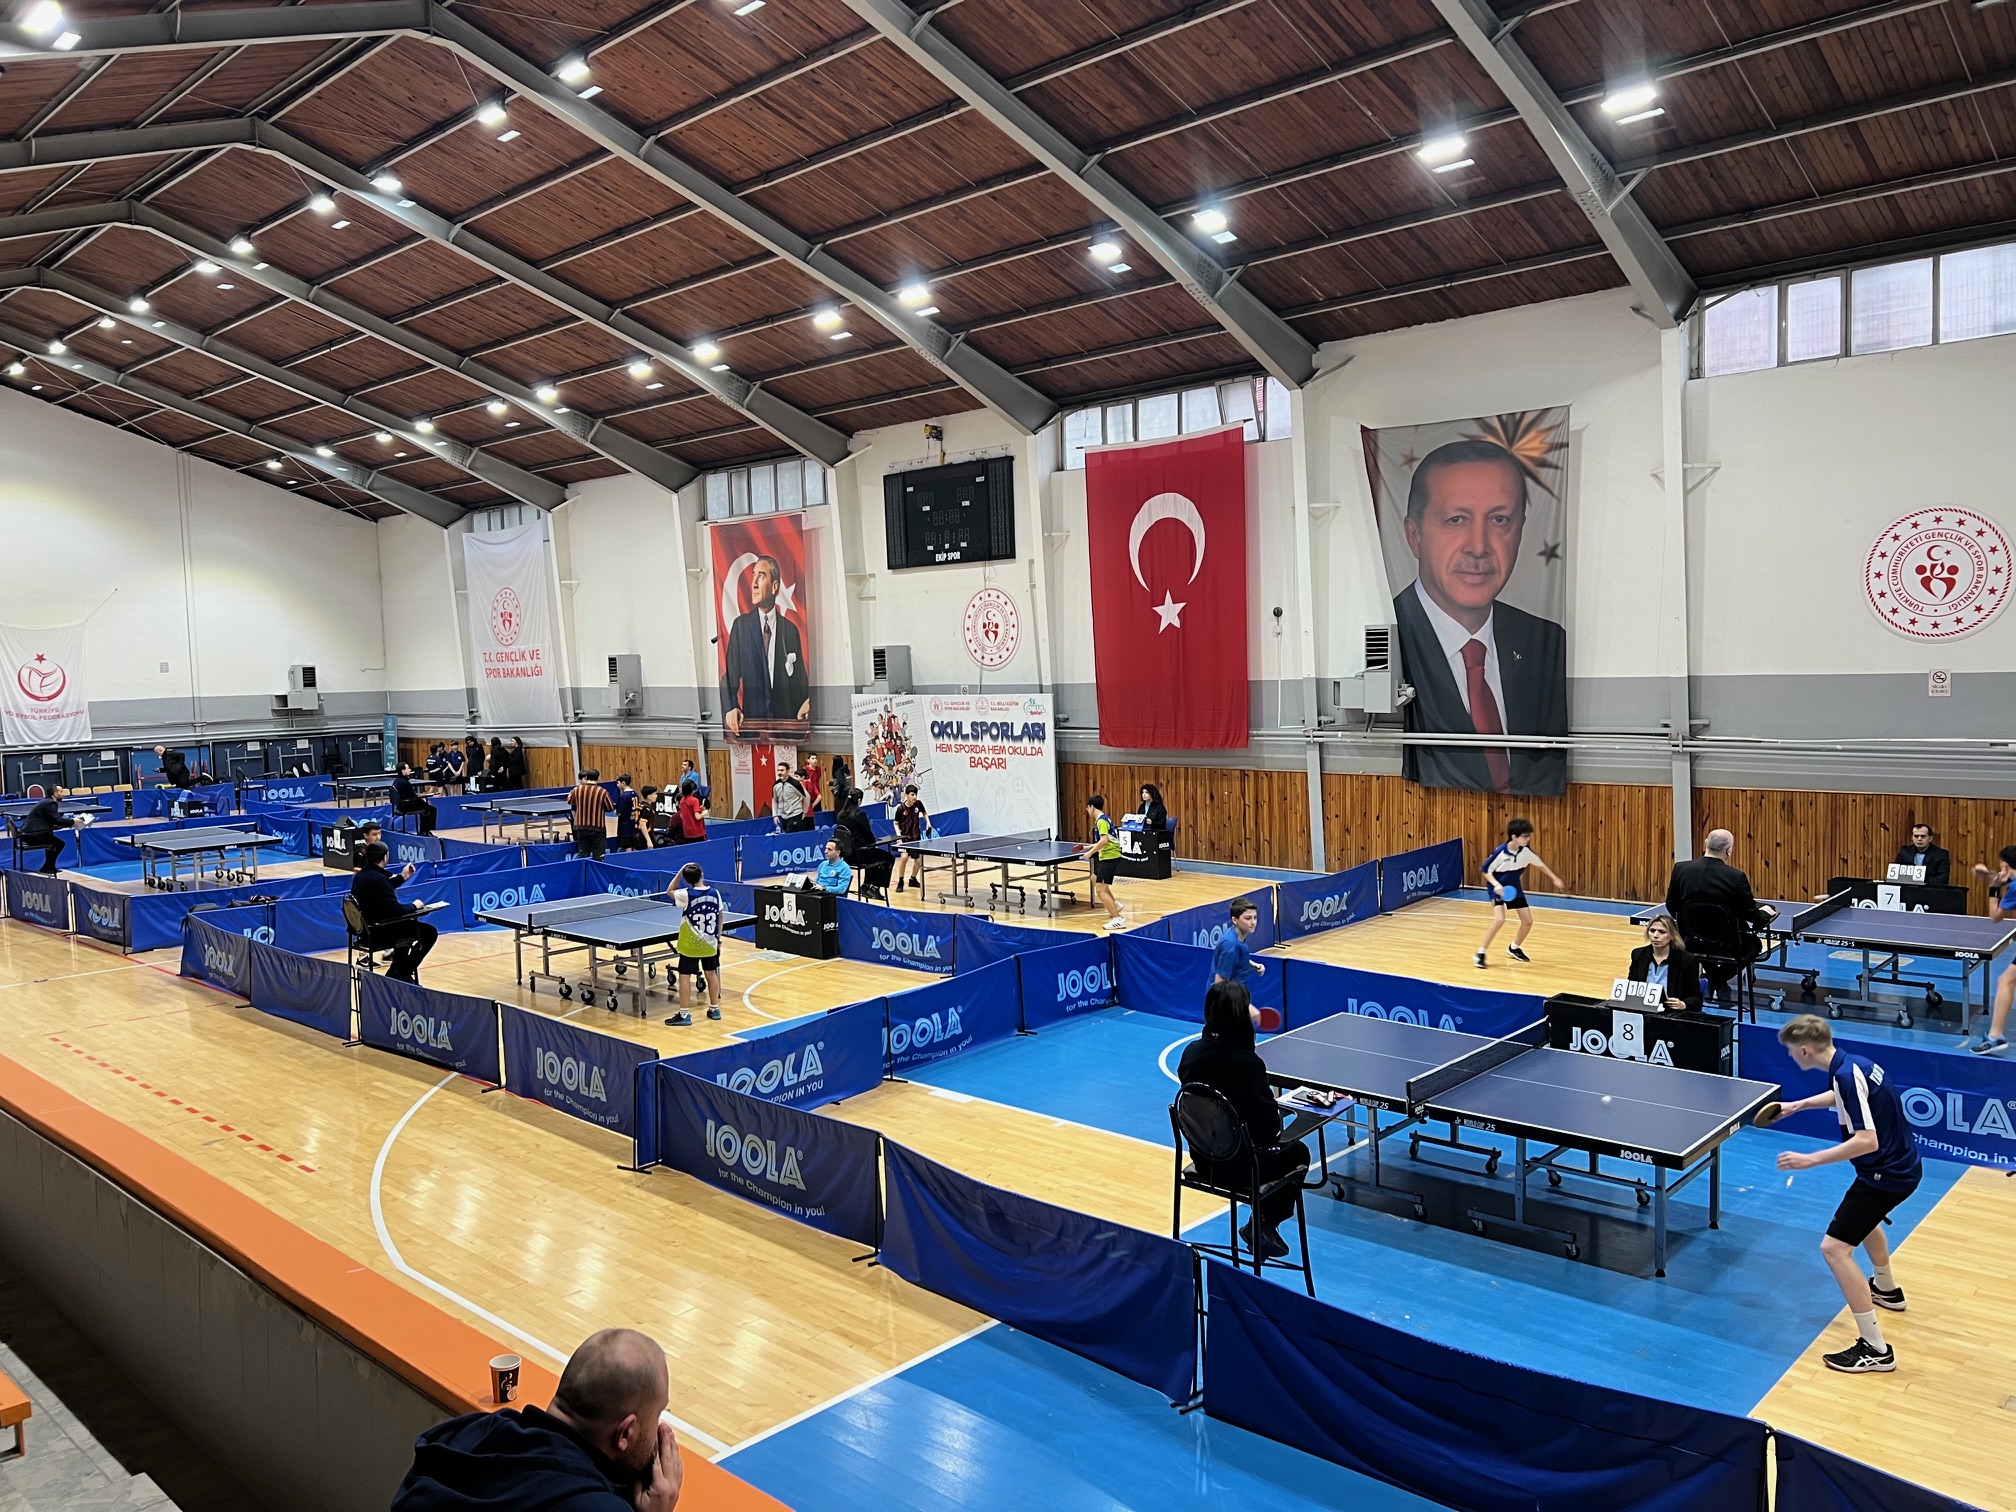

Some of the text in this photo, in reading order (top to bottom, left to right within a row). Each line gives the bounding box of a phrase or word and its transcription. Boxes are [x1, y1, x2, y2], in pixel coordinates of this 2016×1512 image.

[947, 551, 961, 560] SPOR
[1891, 531, 1984, 612] TÜRKİYE CUMHURİYETİ GENÇLİK VE SPOR BAKANLIĞI
[483, 649, 541, 665] T.C. GENÇLİK VE
[485, 664, 543, 678] SPOR BAKANLIĞI
[930, 720, 1046, 742] OKUL SPORLARI
[935, 743, 1044, 757] HEM SPORDA HEM OKULDA
[969, 756, 1007, 771] BAŞARI
[326, 836, 346, 850] JOA
[1123, 836, 1128, 845] 5
[398, 844, 425, 861] JOOLA
[770, 845, 824, 868] JOOLA
[1402, 863, 1439, 892] JOOLA
[1889, 867, 1896, 877] 5
[1915, 869, 1922, 879] 3
[21, 889, 52, 914] JOOLA
[472, 883, 546, 913] JOOLA
[787, 901, 793, 911] 6
[1301, 890, 1350, 922] JOOLA
[1885, 893, 1894, 905] 7
[692, 912, 717, 934] 33
[765, 904, 805, 926] JOA
[872, 927, 941, 958] JOOLA
[1193, 922, 1228, 949] JOO
[1955, 951, 1979, 959] JOOLA
[902, 958, 934, 971] Champion
[1057, 962, 1113, 1002] JOOL
[1630, 985, 1635, 995] 1
[1638, 985, 1645, 996] 0
[1614, 983, 1623, 999] 6
[1647, 988, 1657, 1004] 5
[1066, 1003, 1076, 1012] for
[1077, 1000, 1088, 1008] the
[390, 1007, 453, 1051] JOOLA
[882, 1005, 962, 1056] JOOLA
[1622, 1023, 1635, 1041] 8
[897, 1055, 910, 1064] the
[912, 1050, 948, 1060] Champion
[949, 1046, 957, 1054] in
[1569, 1026, 1674, 1067] JOA
[536, 1047, 607, 1102] JOOLA
[795, 1087, 805, 1097] IN
[806, 1079, 824, 1093] YOU
[544, 1088, 620, 1125] for the Champion in you!
[1379, 1101, 1389, 1110] 25
[1900, 1087, 2016, 1140] OLA
[1485, 1123, 1496, 1131] 25
[1729, 1122, 1740, 1135] JOOLA
[705, 1118, 807, 1191] JOOLA
[1620, 1150, 1653, 1164] JOOLA
[1994, 1153, 2008, 1164] in
[718, 1168, 826, 1219] for the Champion in you!
